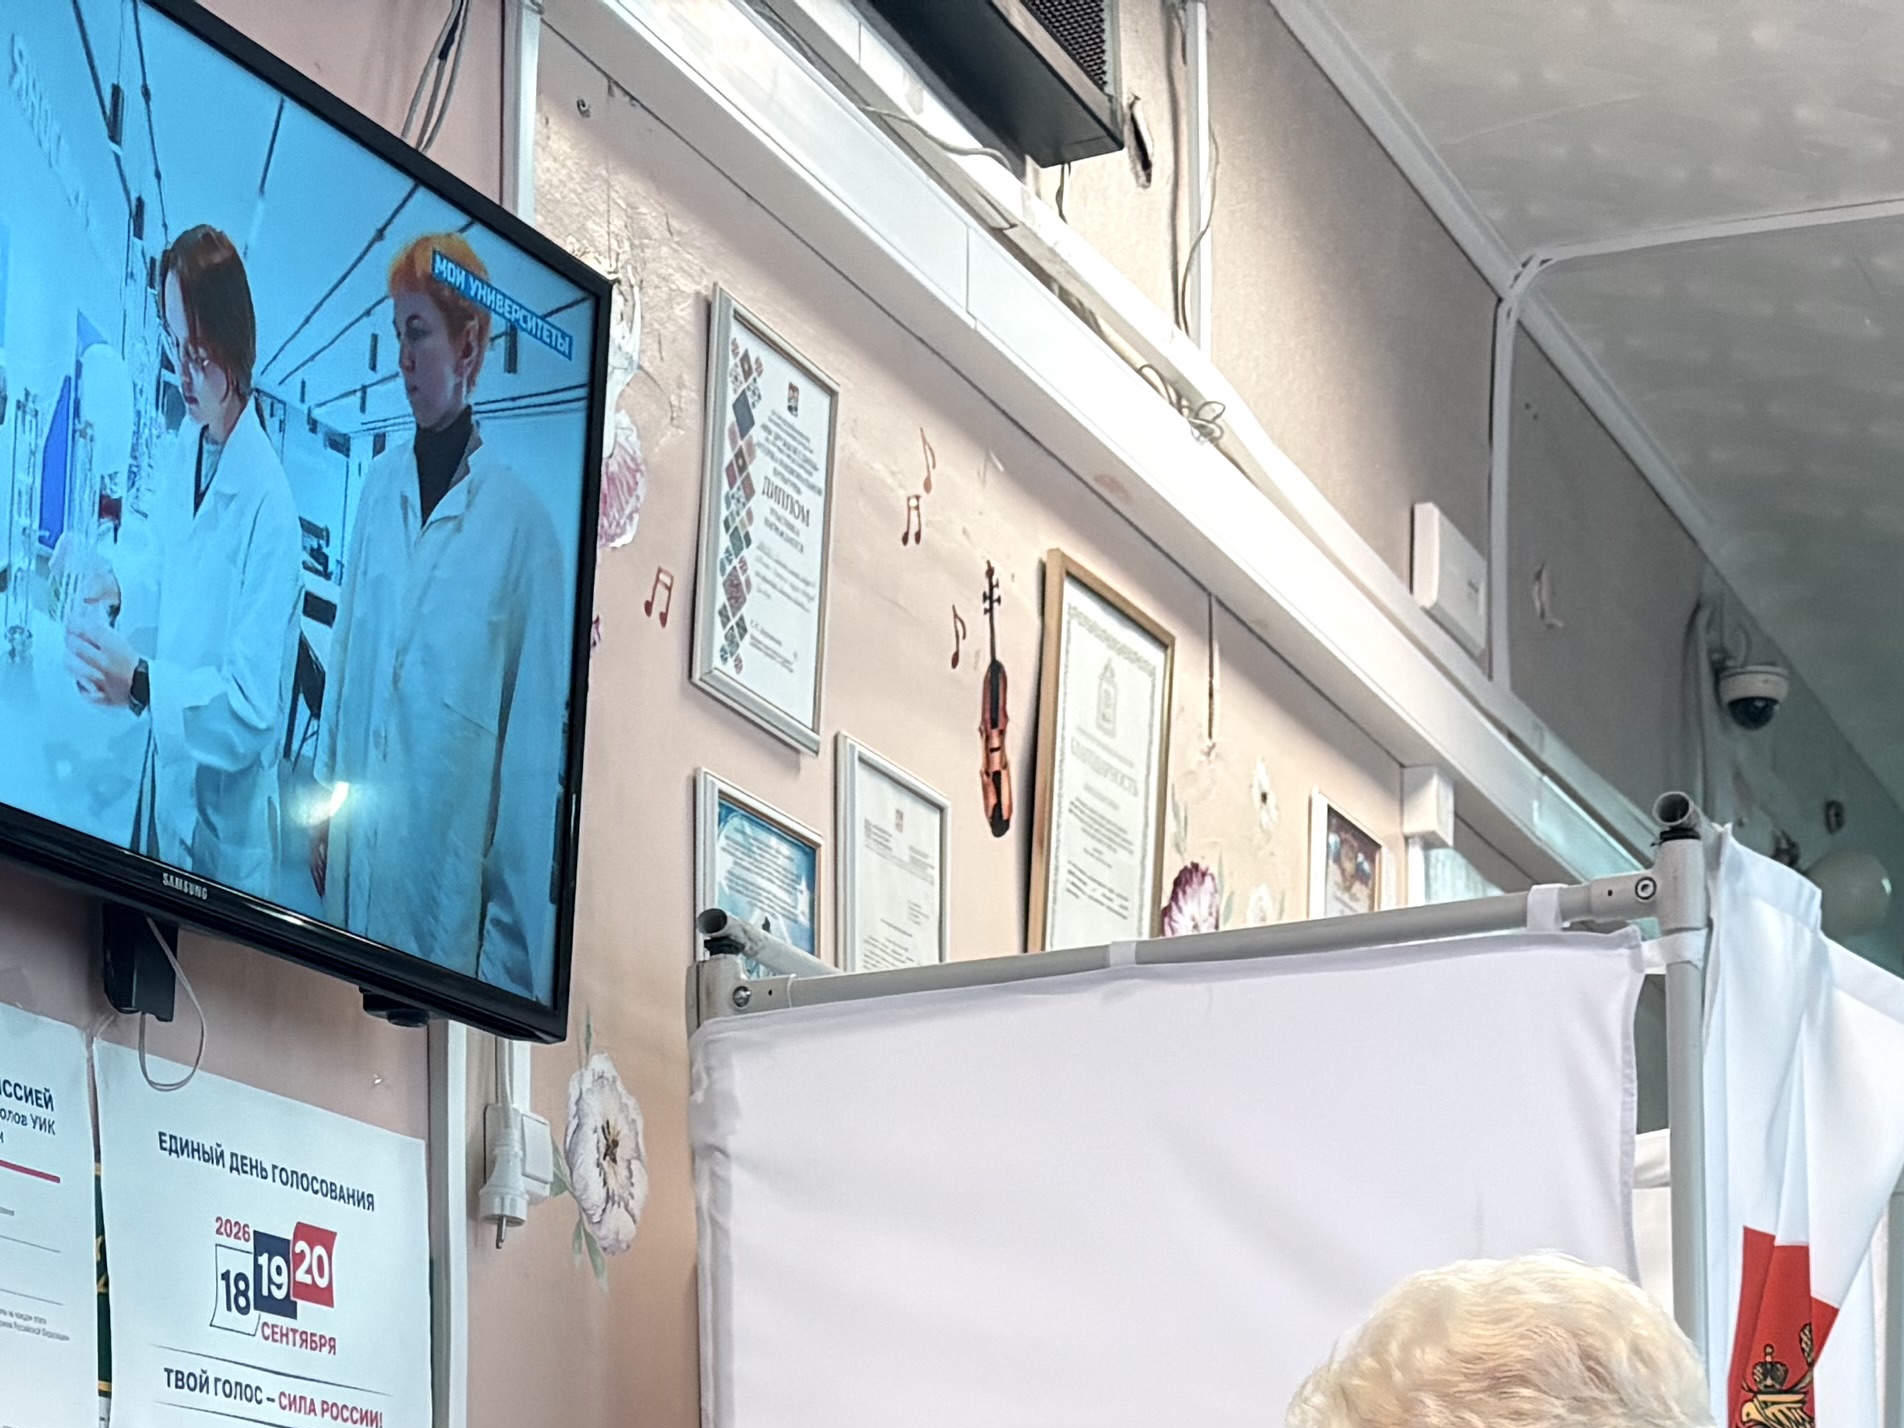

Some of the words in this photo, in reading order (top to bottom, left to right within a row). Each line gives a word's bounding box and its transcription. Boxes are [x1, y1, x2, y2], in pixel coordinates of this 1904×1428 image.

[435, 254, 466, 291] МОИ
[469, 275, 569, 356] УНИВЕРСИТЕТЫ
[762, 476, 810, 528] ДИПЛОМ
[162, 872, 208, 900] SAMSUNG
[30, 1112, 56, 1136] УИК
[158, 1131, 226, 1169] ЕДИНЫЙ
[230, 1152, 268, 1181] ДЕНЬ
[272, 1164, 375, 1212] ГОЛОСОВАНИЯ
[215, 1216, 251, 1243] 2026
[220, 1269, 251, 1317] 18
[257, 1252, 288, 1300] 19
[294, 1241, 330, 1288] 20
[261, 1322, 337, 1356] СЕНТЯБРЯ
[164, 1367, 209, 1396] ТВОЙ
[214, 1378, 263, 1406] ГОЛОС
[278, 1391, 317, 1418] СИЛА
